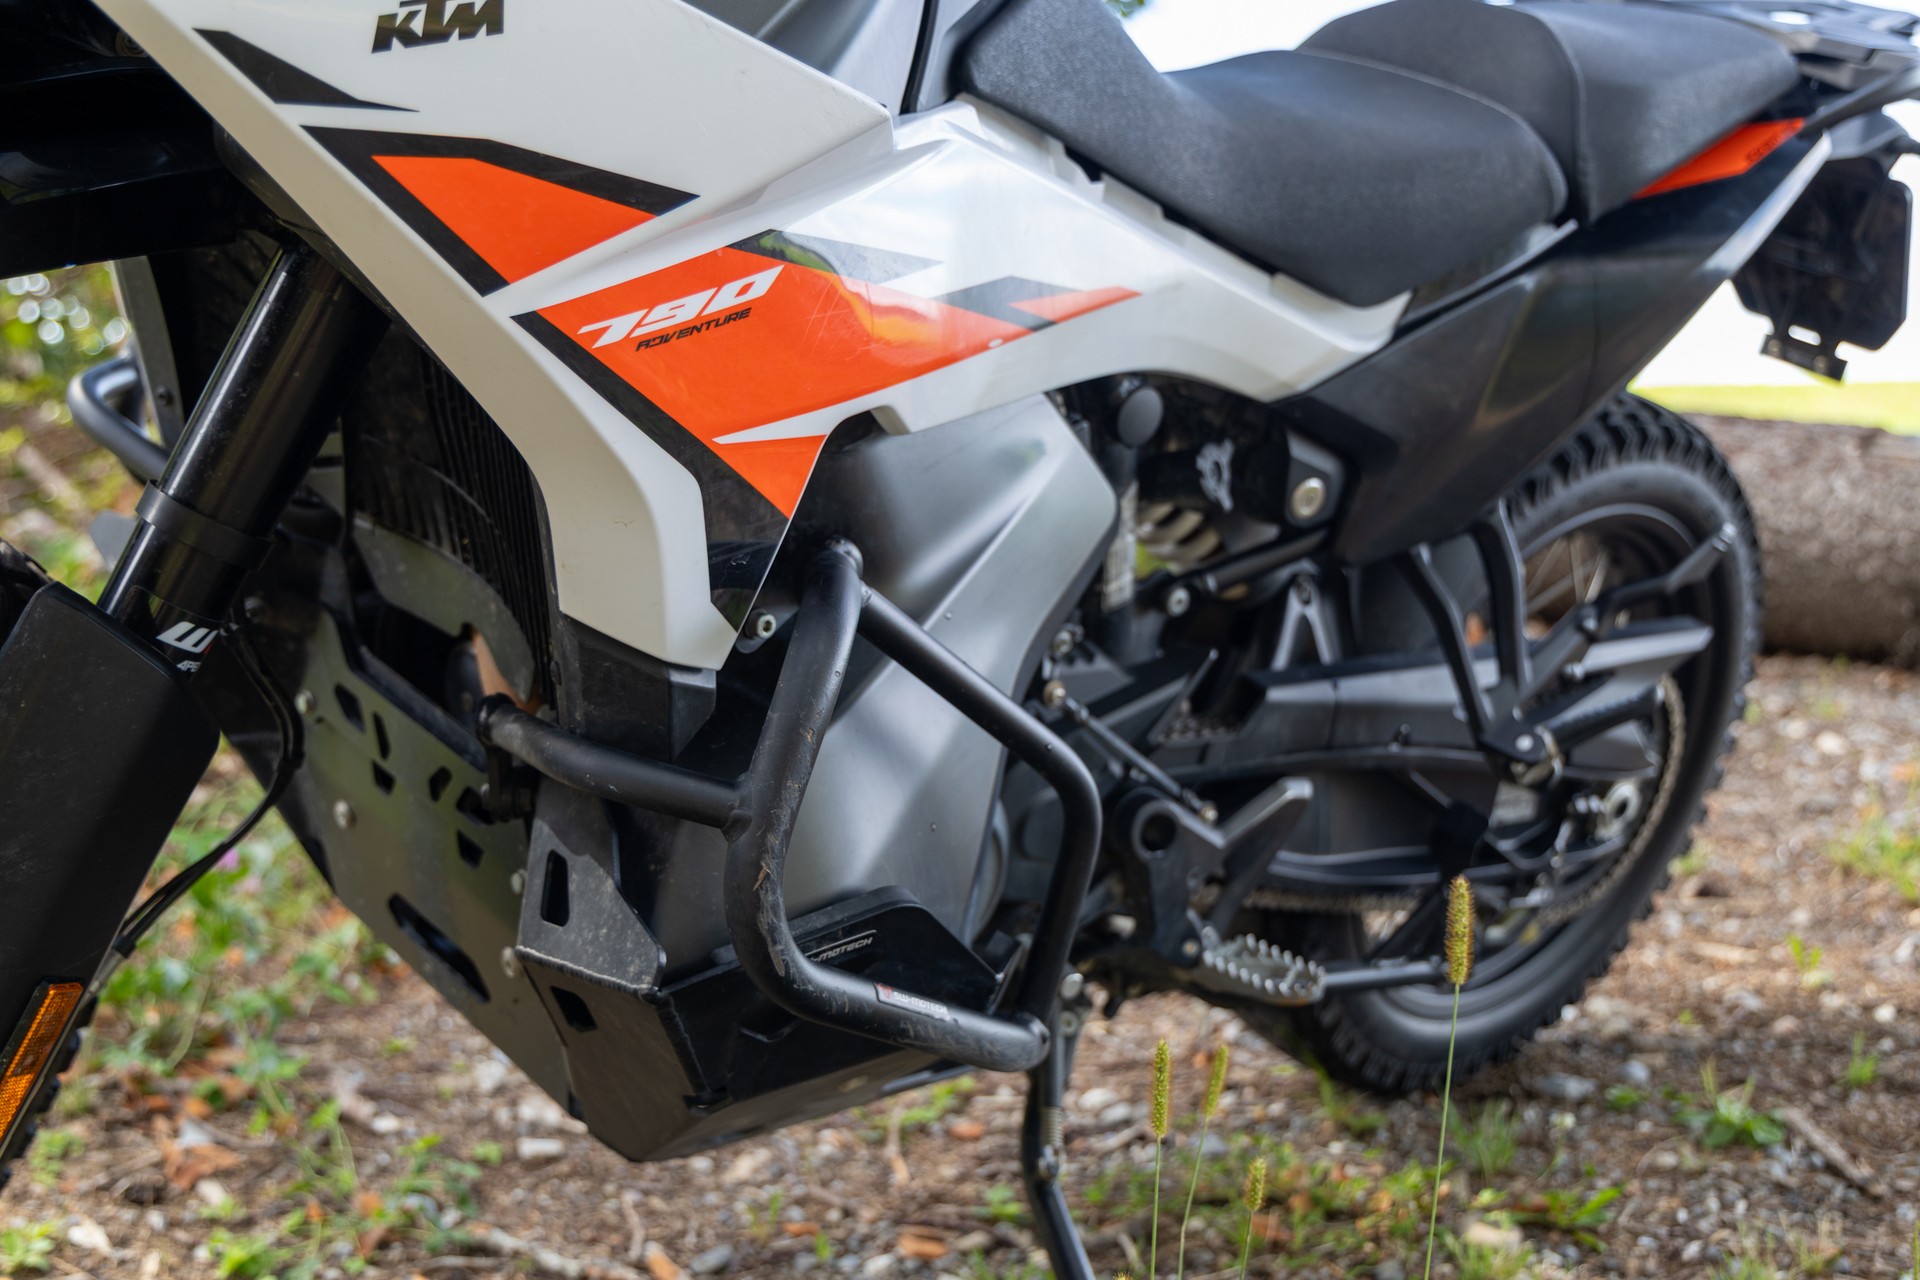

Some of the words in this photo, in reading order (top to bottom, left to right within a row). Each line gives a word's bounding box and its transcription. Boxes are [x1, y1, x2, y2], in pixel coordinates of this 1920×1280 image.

[371, 0, 504, 53] KTM
[576, 264, 785, 349] 790
[635, 307, 752, 352] ADVENTURE
[155, 621, 219, 654] W
[176, 660, 202, 673] APE
